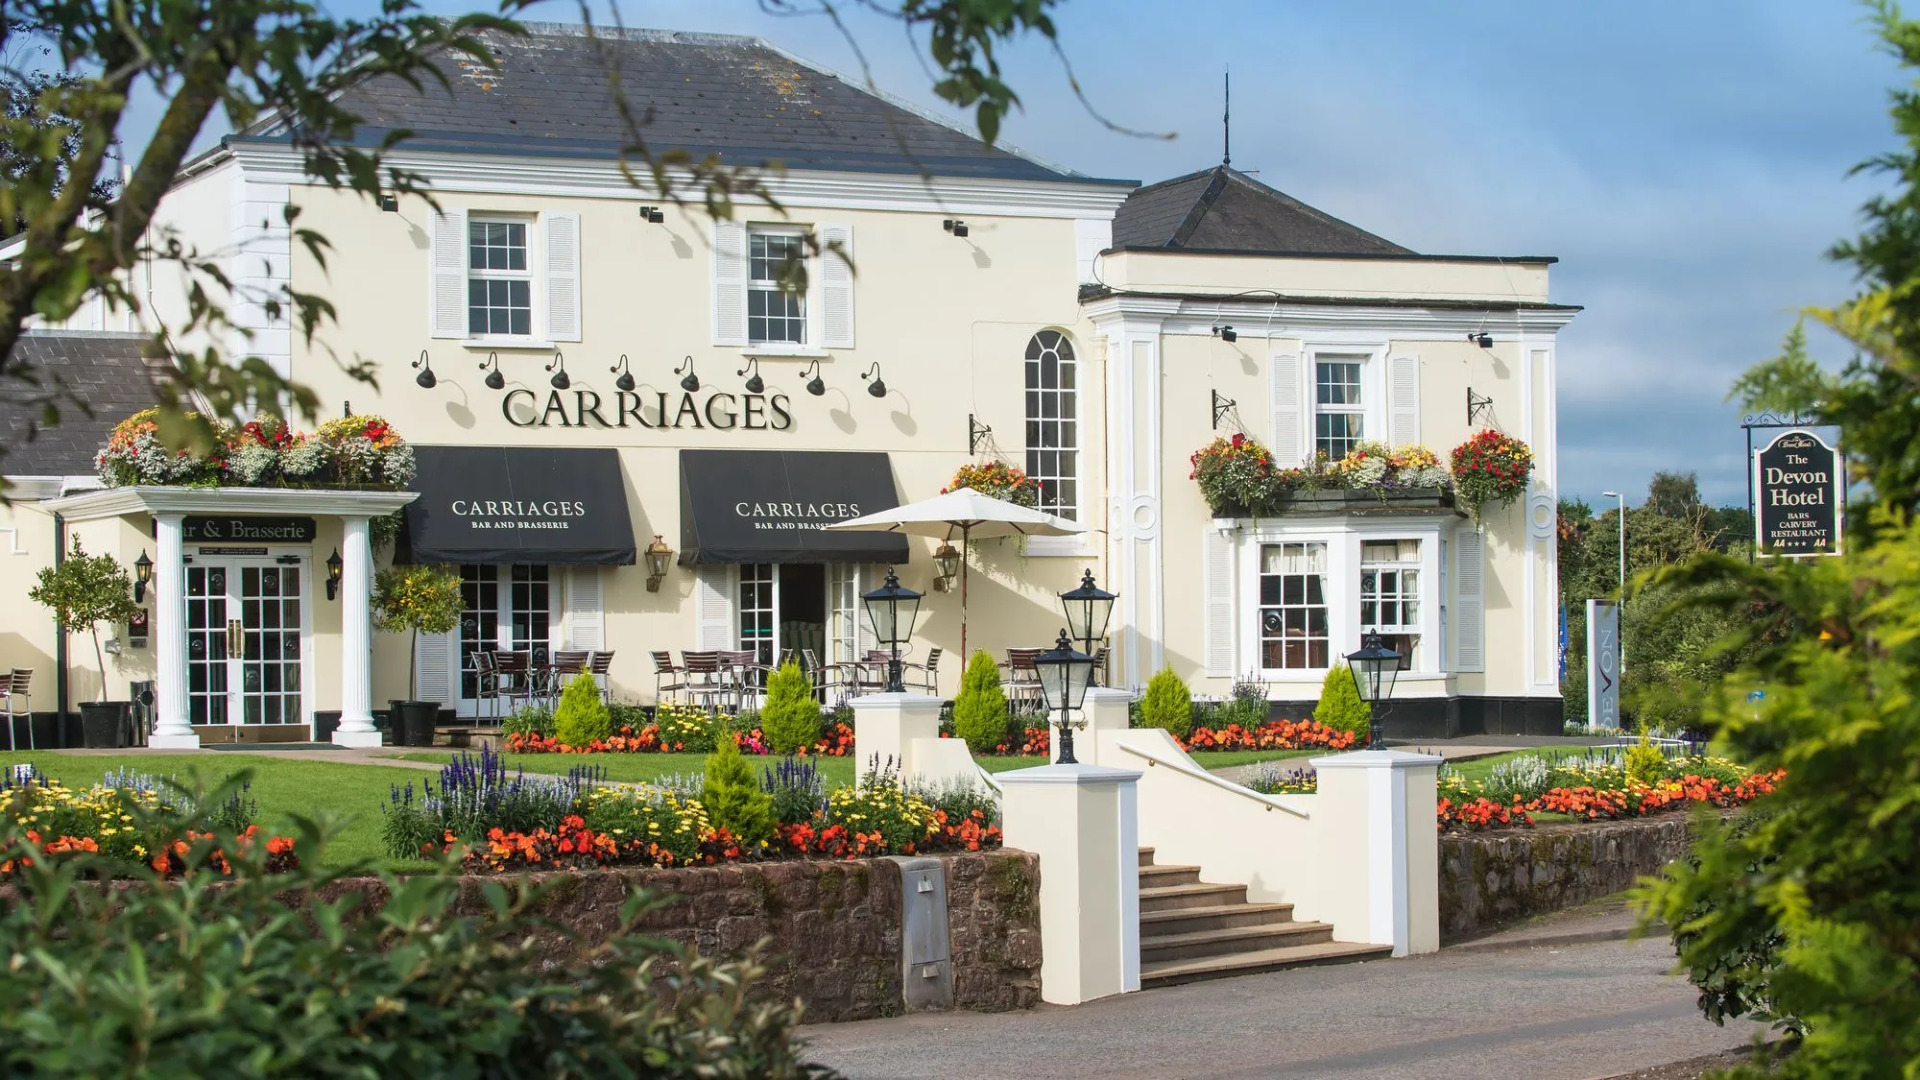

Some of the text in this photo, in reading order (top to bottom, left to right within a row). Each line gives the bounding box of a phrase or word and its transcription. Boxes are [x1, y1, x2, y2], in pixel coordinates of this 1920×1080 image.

[502, 389, 792, 430] CARRIAGES
[1786, 455, 1808, 464] The
[1766, 467, 1827, 484] Devon
[1770, 487, 1824, 506] Hotel
[451, 500, 585, 516] CARRIAGES
[735, 502, 861, 518] CARRIAGES
[203, 520, 222, 538] &
[230, 520, 305, 538] Brasserie
[472, 521, 569, 529] BAR AND BRASSERIE
[1779, 520, 1817, 529] CARVERY
[1771, 529, 1827, 537] RESTAURANT
